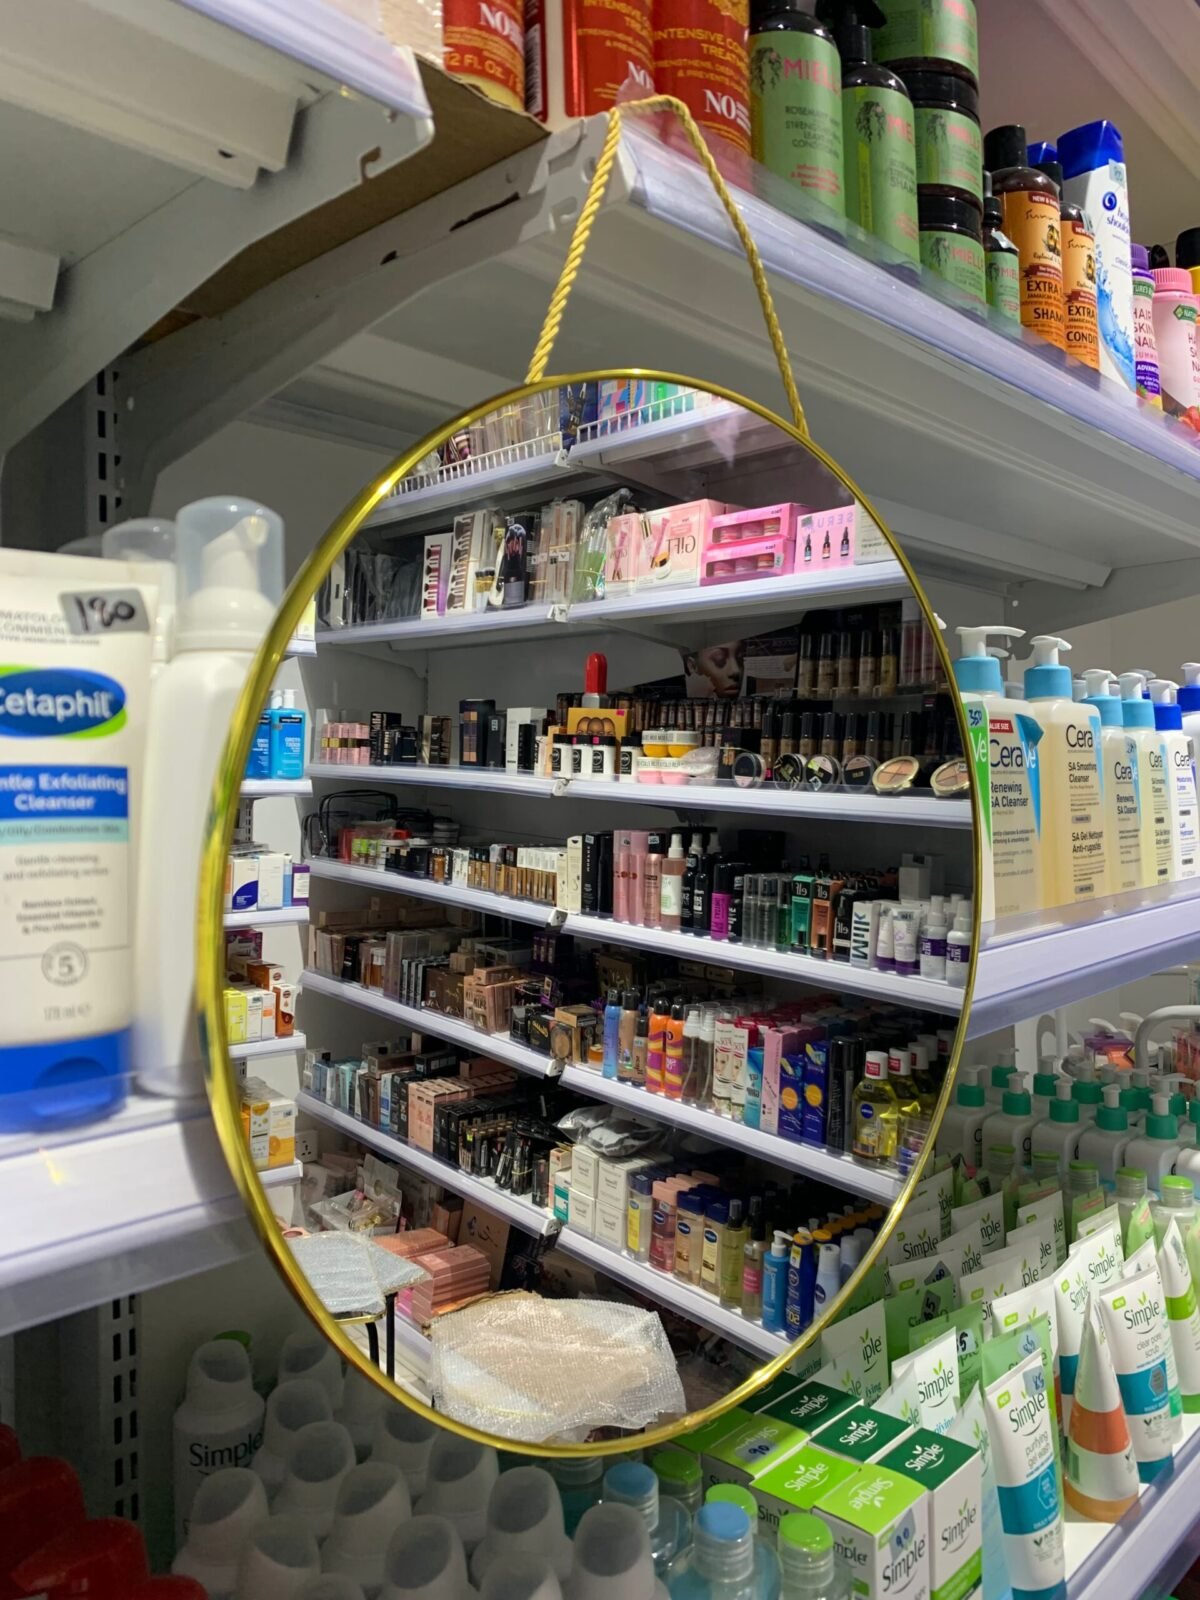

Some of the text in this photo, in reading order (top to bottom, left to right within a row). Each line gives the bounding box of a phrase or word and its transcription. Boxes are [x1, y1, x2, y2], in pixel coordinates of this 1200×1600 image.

[1027, 280, 1059, 296] EXTRA
[1068, 305, 1095, 318] EXTRA
[1068, 761, 1076, 772] SA
[1069, 773, 1089, 784] Cleanser
[38, 773, 126, 793] Exfoliating
[14, 793, 95, 812] Cleanser
[1001, 795, 1028, 808] Cleanser
[1072, 832, 1080, 842] SA
[58, 955, 74, 977] 5
[903, 1236, 939, 1260] Simple
[1088, 1255, 1115, 1280] Simple
[1124, 1300, 1160, 1330] Simple
[1137, 1332, 1162, 1351] clear pore
[1145, 1345, 1159, 1358] scrub
[918, 1370, 954, 1404] Simple
[791, 1393, 829, 1418] Simple
[1009, 1392, 1045, 1434] Simple
[840, 1418, 878, 1446] Simple
[189, 1432, 264, 1468] Simple
[905, 1442, 943, 1472] Simple
[784, 1461, 829, 1492] Simple
[849, 1478, 894, 1512] Simple
[941, 1507, 977, 1552] Simple
[882, 1538, 926, 1593] Simple
